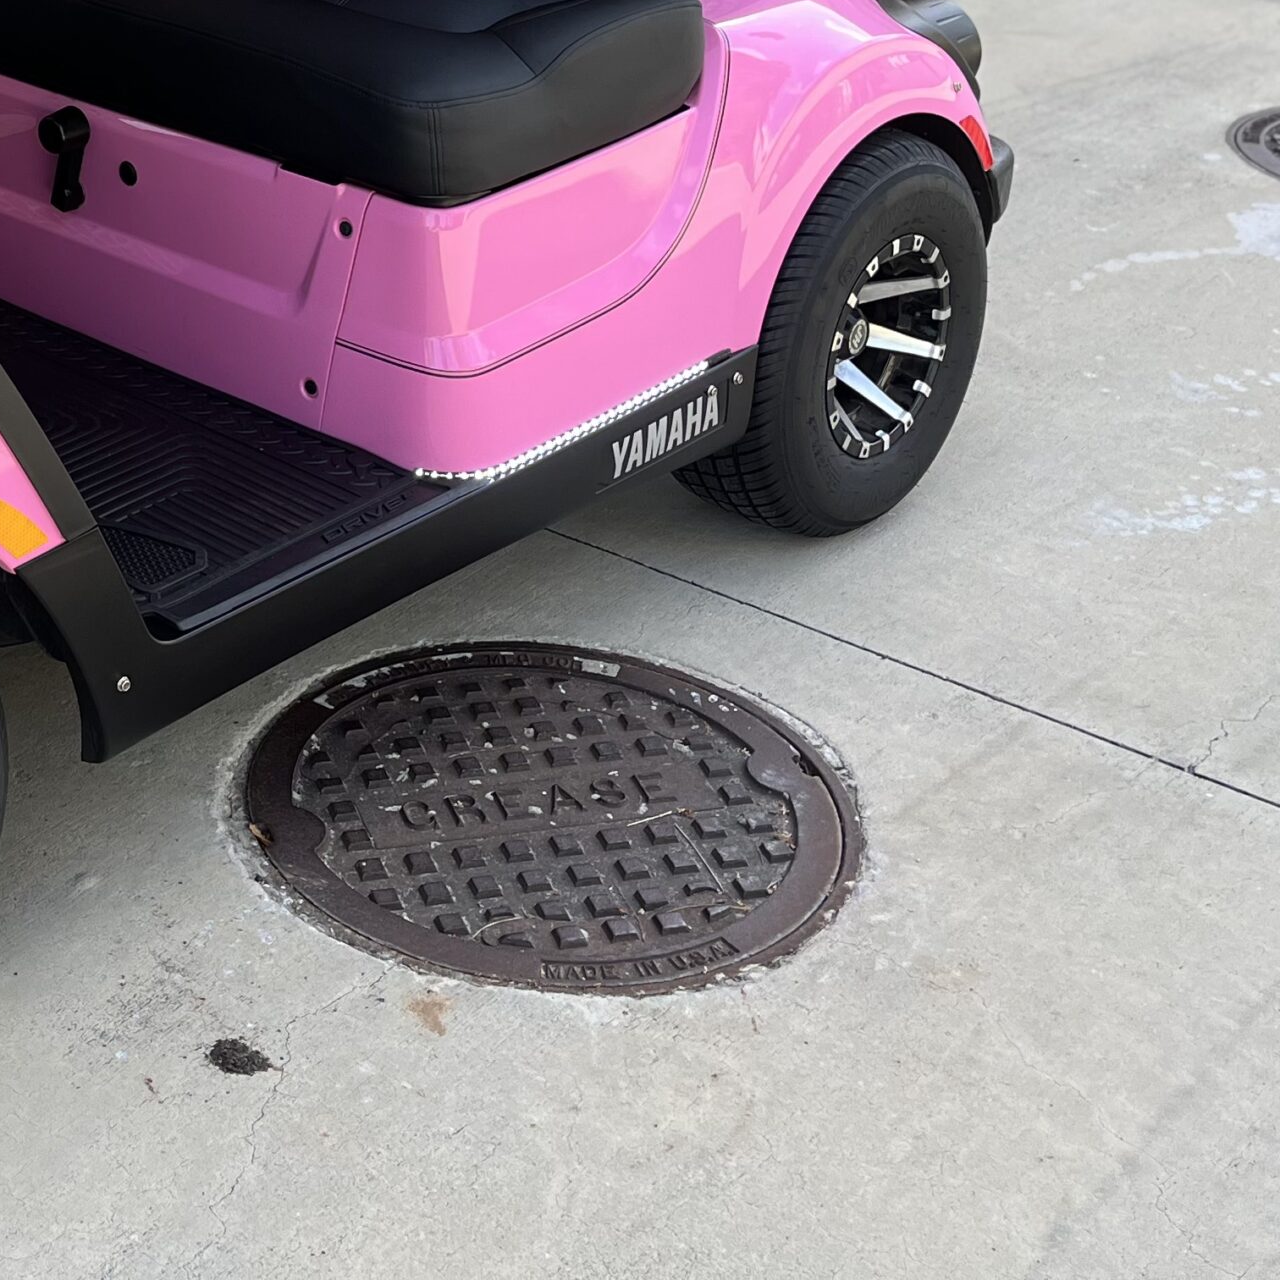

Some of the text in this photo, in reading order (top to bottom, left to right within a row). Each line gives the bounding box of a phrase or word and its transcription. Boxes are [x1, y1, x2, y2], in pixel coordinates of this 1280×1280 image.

[612, 393, 719, 480] YAMAHA
[399, 771, 678, 830] GREASE
[543, 962, 621, 980] MADE
[634, 960, 662, 978] IN
